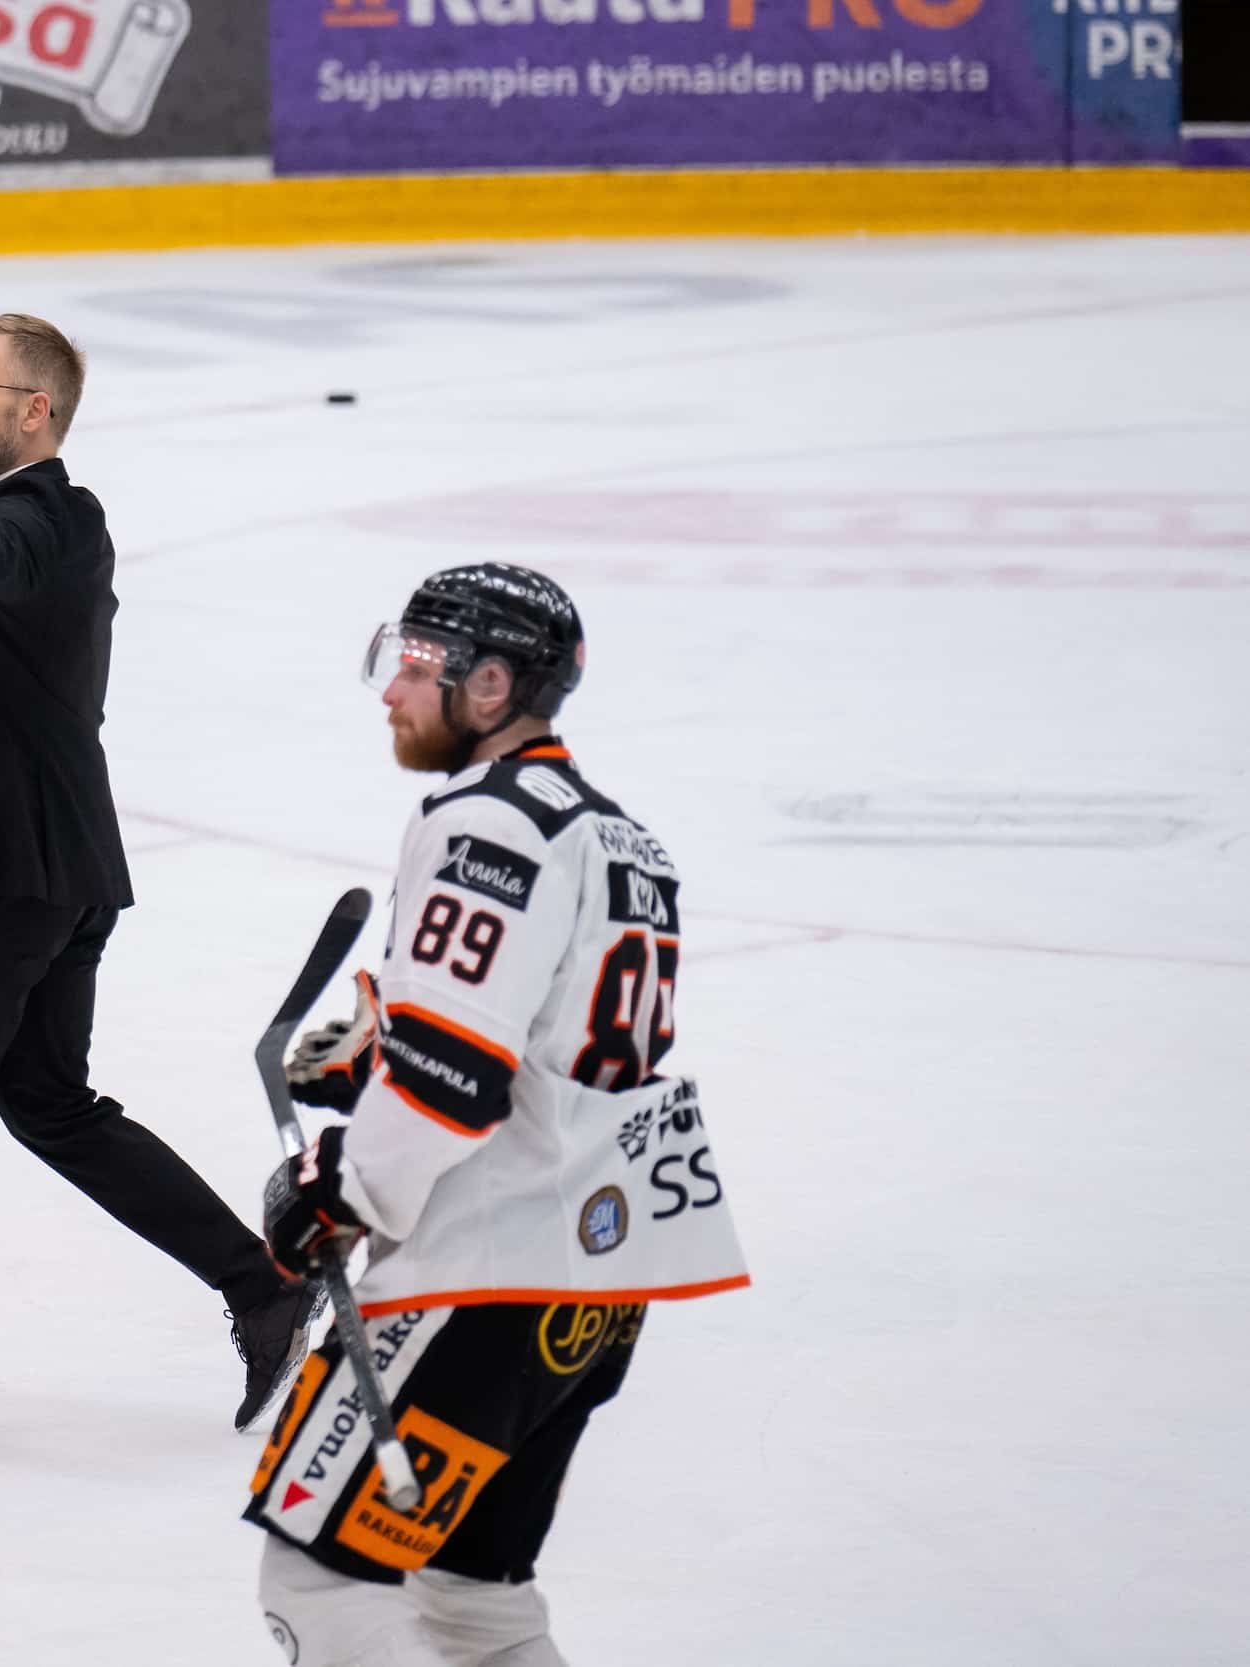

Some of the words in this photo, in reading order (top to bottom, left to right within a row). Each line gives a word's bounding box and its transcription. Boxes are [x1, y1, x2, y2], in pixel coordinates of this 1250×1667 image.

[317, 57, 578, 111] Sujuvampien
[587, 53, 803, 106] työmaiden
[813, 51, 989, 101] puolesta
[1087, 21, 1180, 80] PR
[411, 893, 505, 987] 89
[302, 1308, 425, 1482] vuokako
